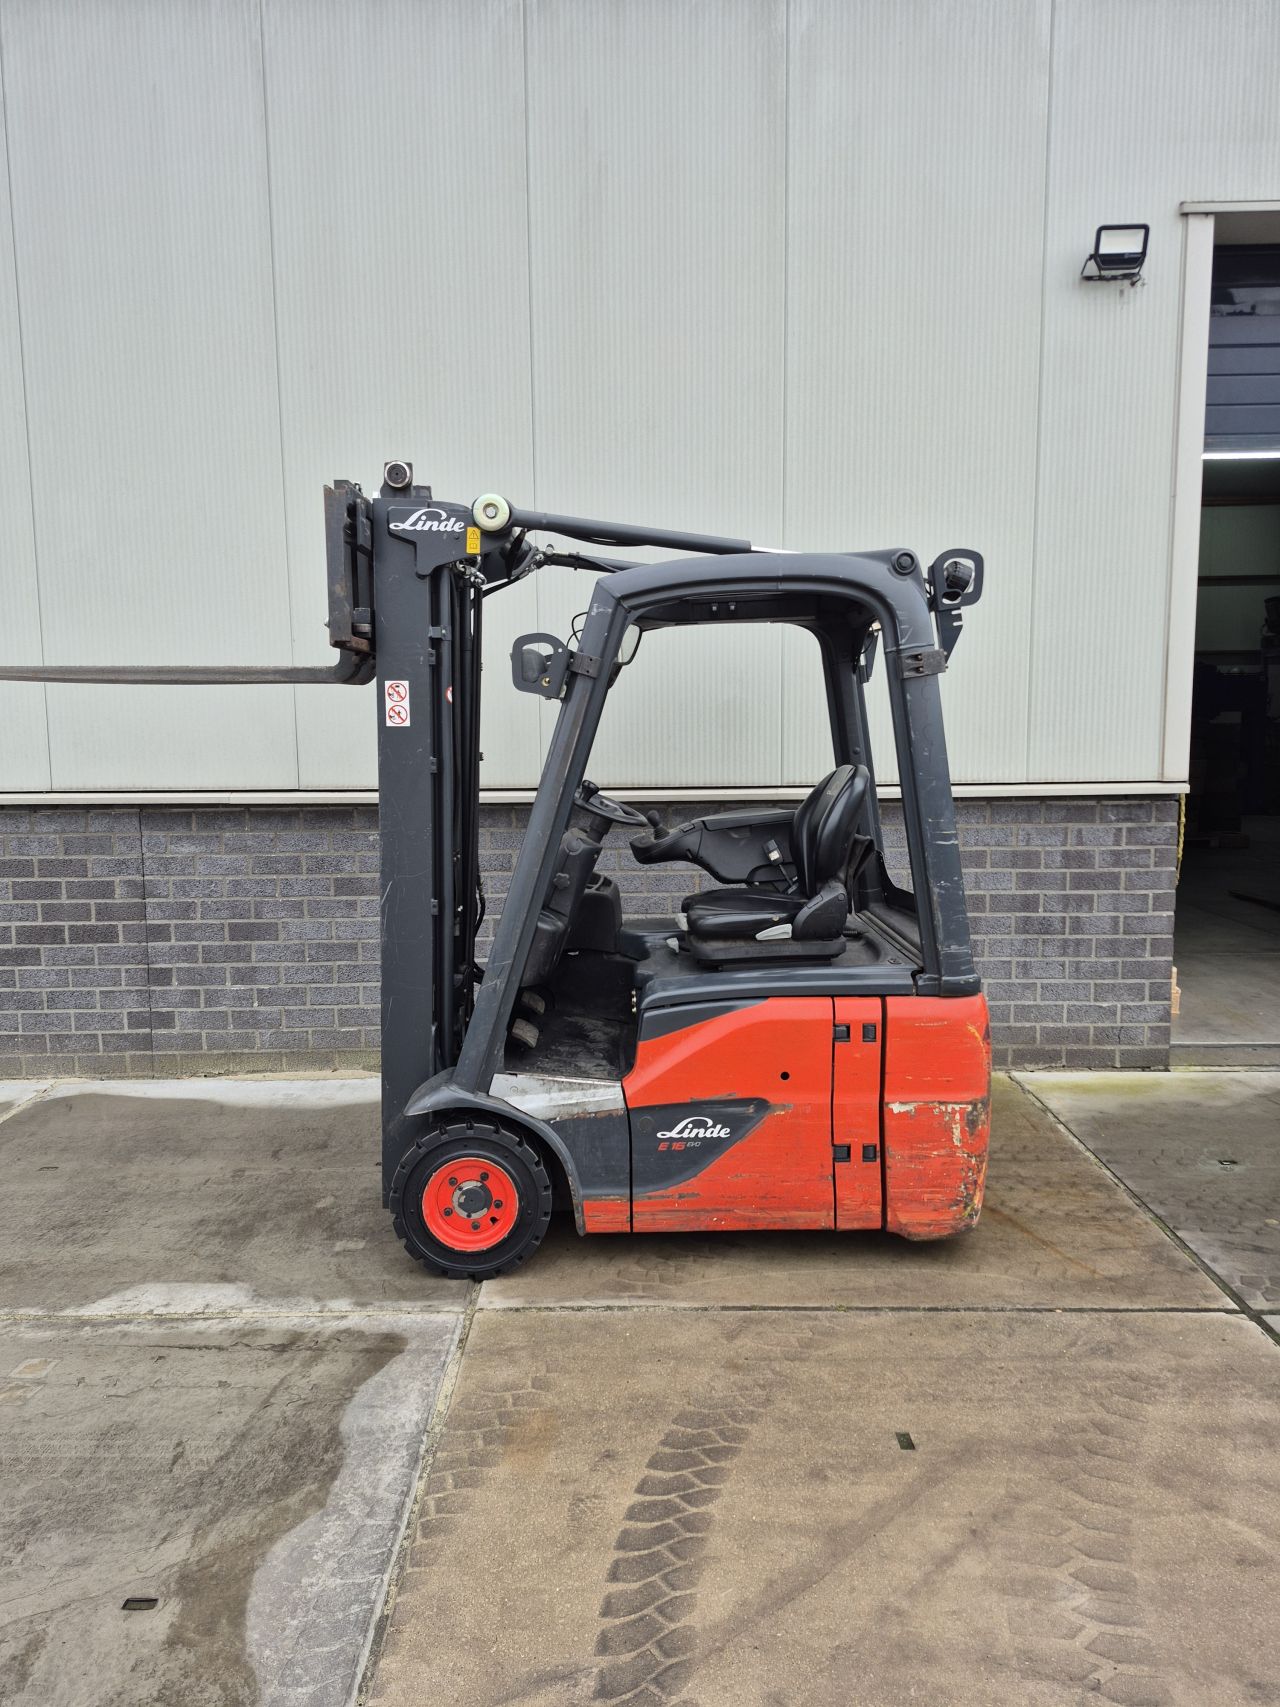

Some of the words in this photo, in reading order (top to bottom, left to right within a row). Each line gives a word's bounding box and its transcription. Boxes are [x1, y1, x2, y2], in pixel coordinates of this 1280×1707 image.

[389, 508, 465, 532] Linde
[656, 1116, 731, 1138] Linde
[658, 1141, 669, 1151] E
[671, 1141, 687, 1151] 16
